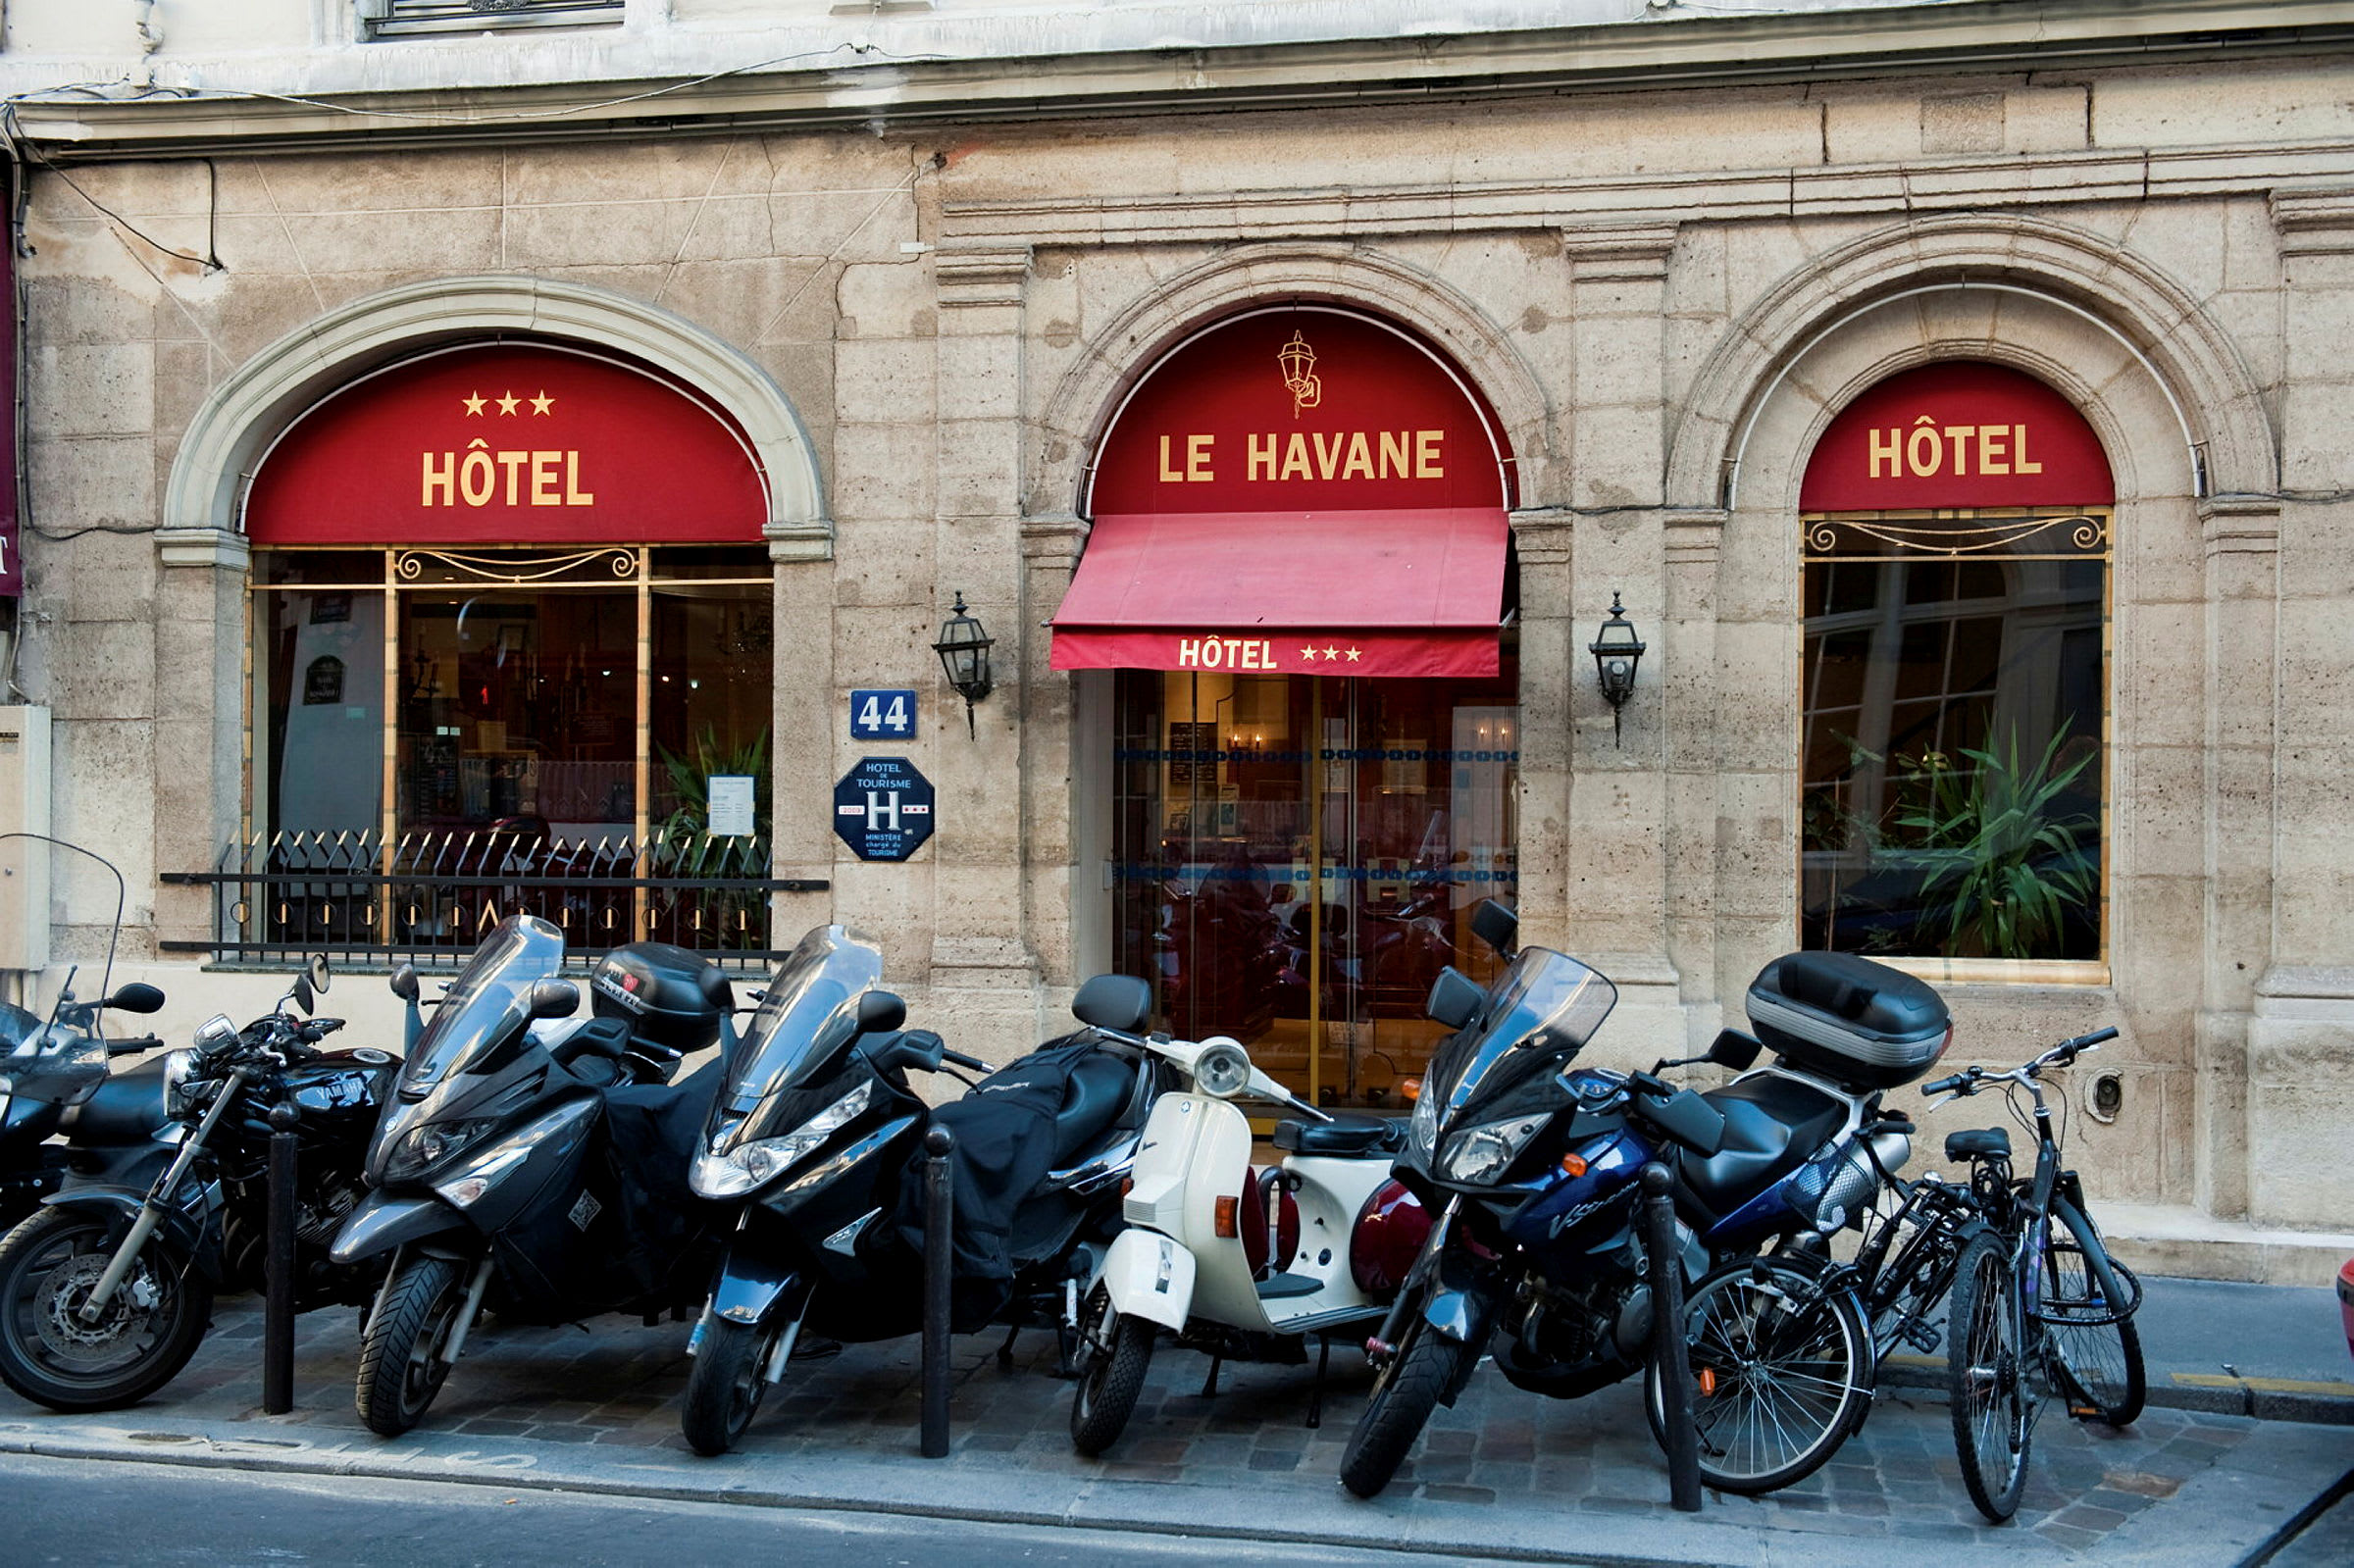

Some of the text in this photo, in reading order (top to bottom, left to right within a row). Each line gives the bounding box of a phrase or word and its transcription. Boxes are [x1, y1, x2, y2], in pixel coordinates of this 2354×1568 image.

[1159, 430, 1444, 481] LE HAVANE
[1869, 415, 2042, 478] HÔTEL
[422, 438, 594, 507] HÔTEL
[1179, 634, 1277, 669] HÔTEL
[858, 695, 908, 732] 44
[856, 779, 911, 788] TOURISME
[866, 763, 901, 773] HOTEL
[866, 791, 901, 831] H
[316, 1079, 366, 1100] YAMAHA
